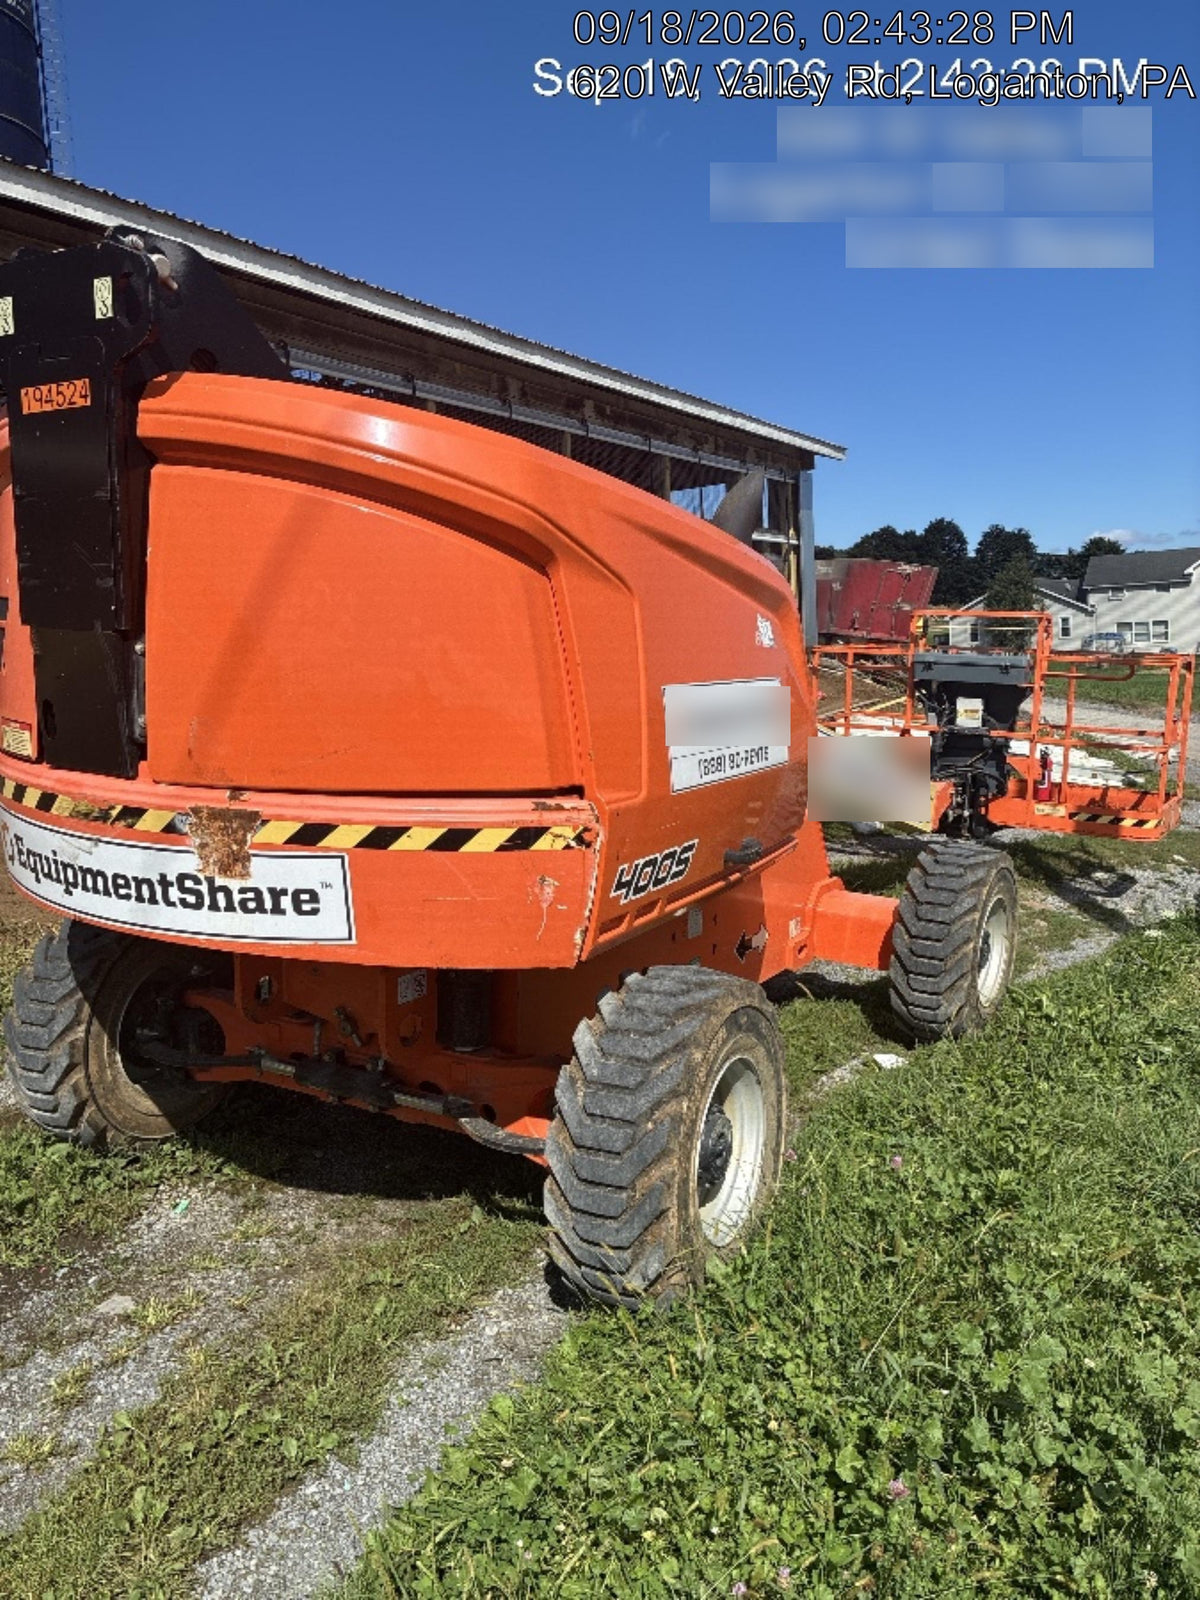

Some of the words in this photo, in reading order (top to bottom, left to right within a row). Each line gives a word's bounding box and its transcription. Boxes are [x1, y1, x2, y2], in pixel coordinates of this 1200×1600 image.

[23, 380, 89, 411] 194524
[14, 833, 321, 917] EquipmentShare
[610, 839, 699, 904] 400S
